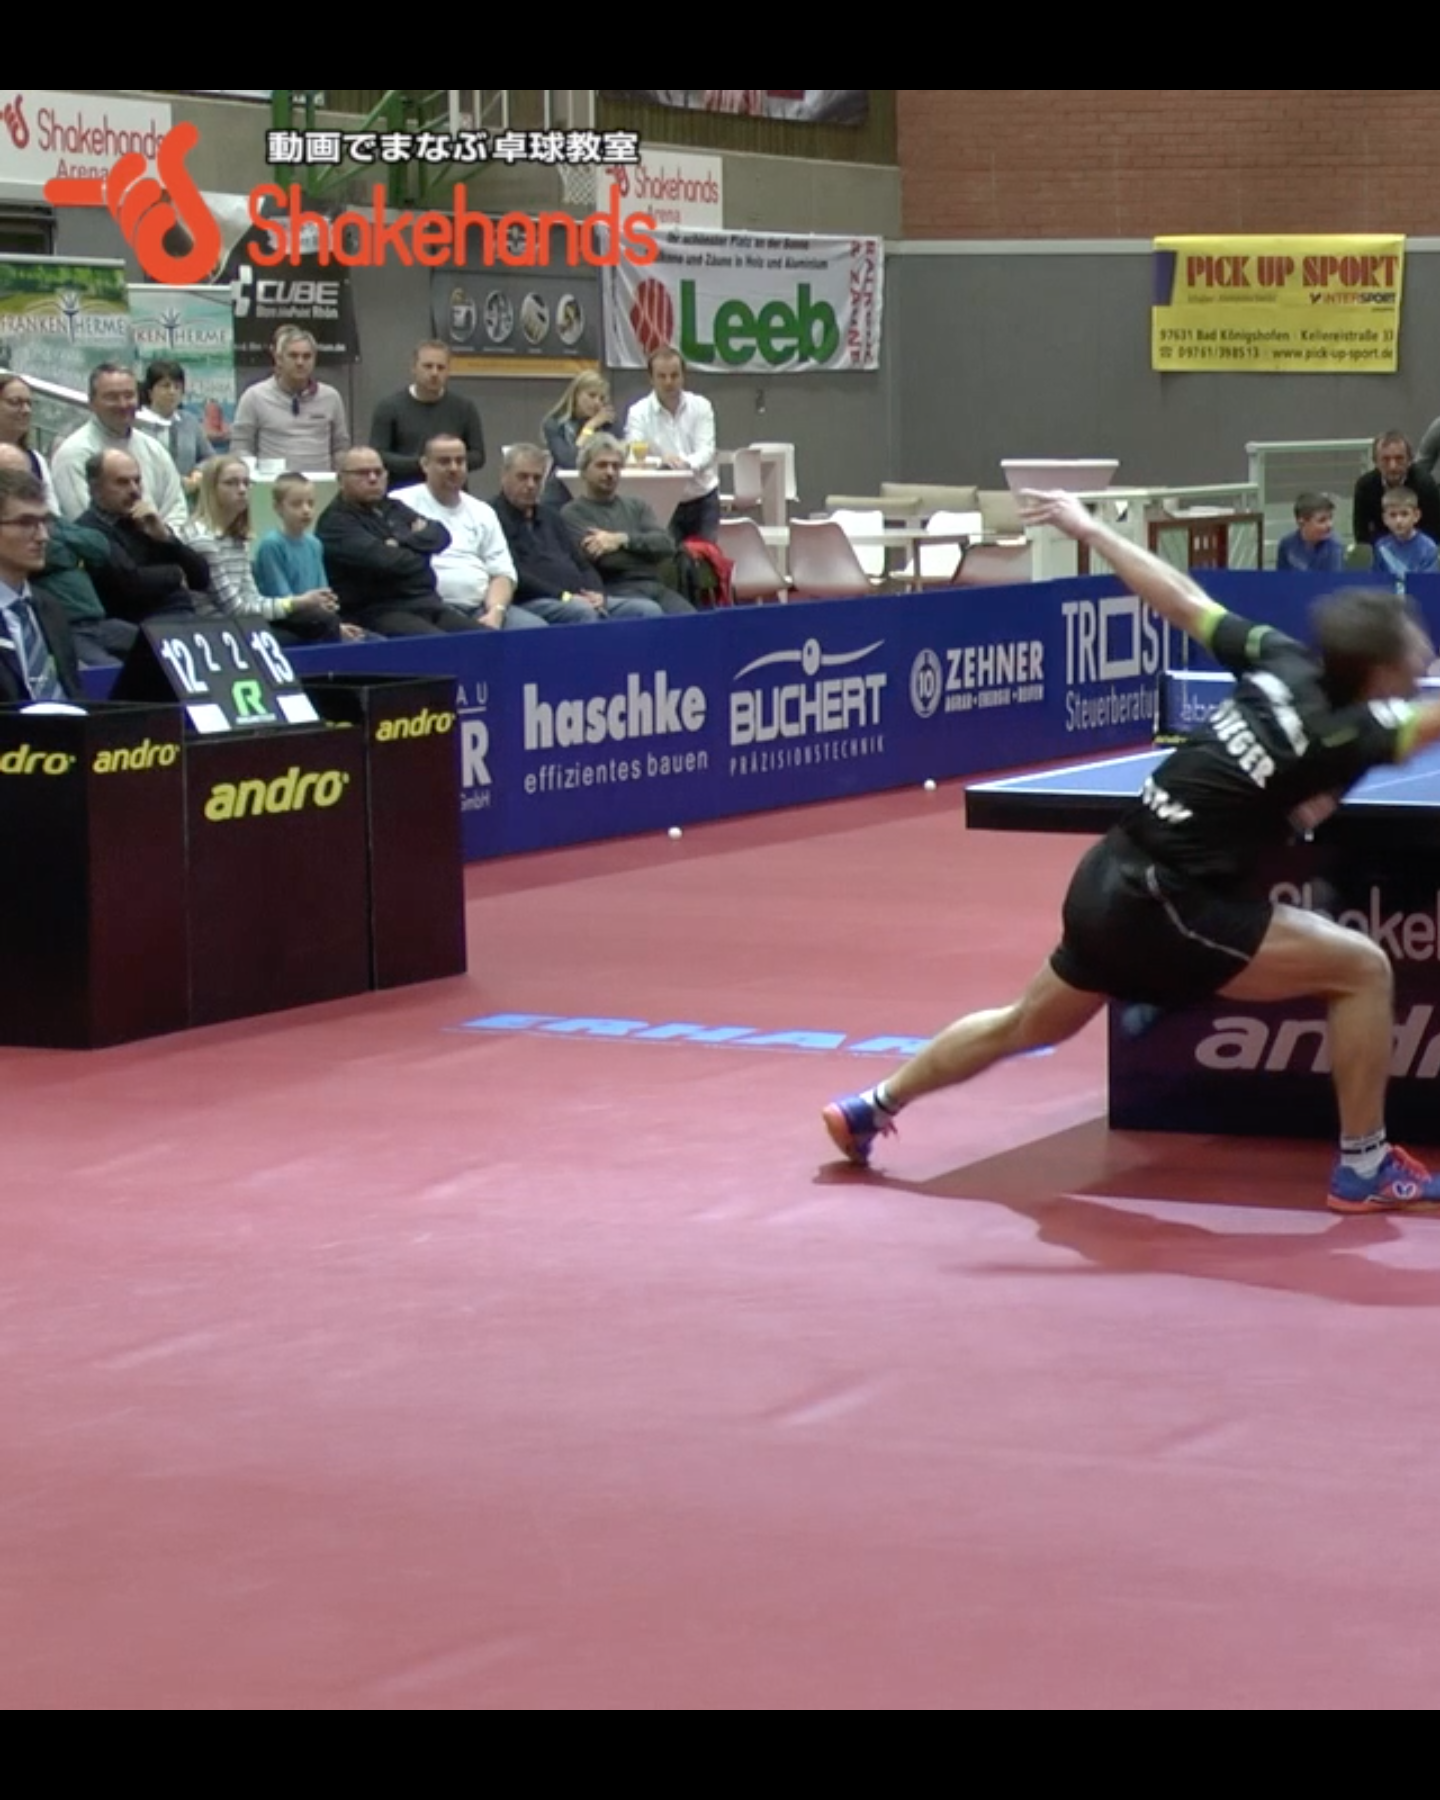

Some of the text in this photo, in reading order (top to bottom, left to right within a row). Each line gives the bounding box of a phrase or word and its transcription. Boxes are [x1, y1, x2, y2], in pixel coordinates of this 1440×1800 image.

[635, 165, 719, 204] Shakehands
[256, 279, 340, 305] CUBE
[1187, 255, 1399, 288] PICK UP SPORT
[680, 279, 839, 366] Leeb
[161, 631, 293, 693] 12 2 2 13
[946, 641, 1044, 691] ZEHNER
[375, 709, 451, 742] andro
[523, 670, 708, 750] haschke
[730, 673, 887, 746] BUCHERT
[93, 739, 177, 773] andro
[524, 750, 708, 794] effizientes bauen
[730, 735, 884, 777] PRÄZISIONSTECHNIK
[204, 768, 345, 821] andro
